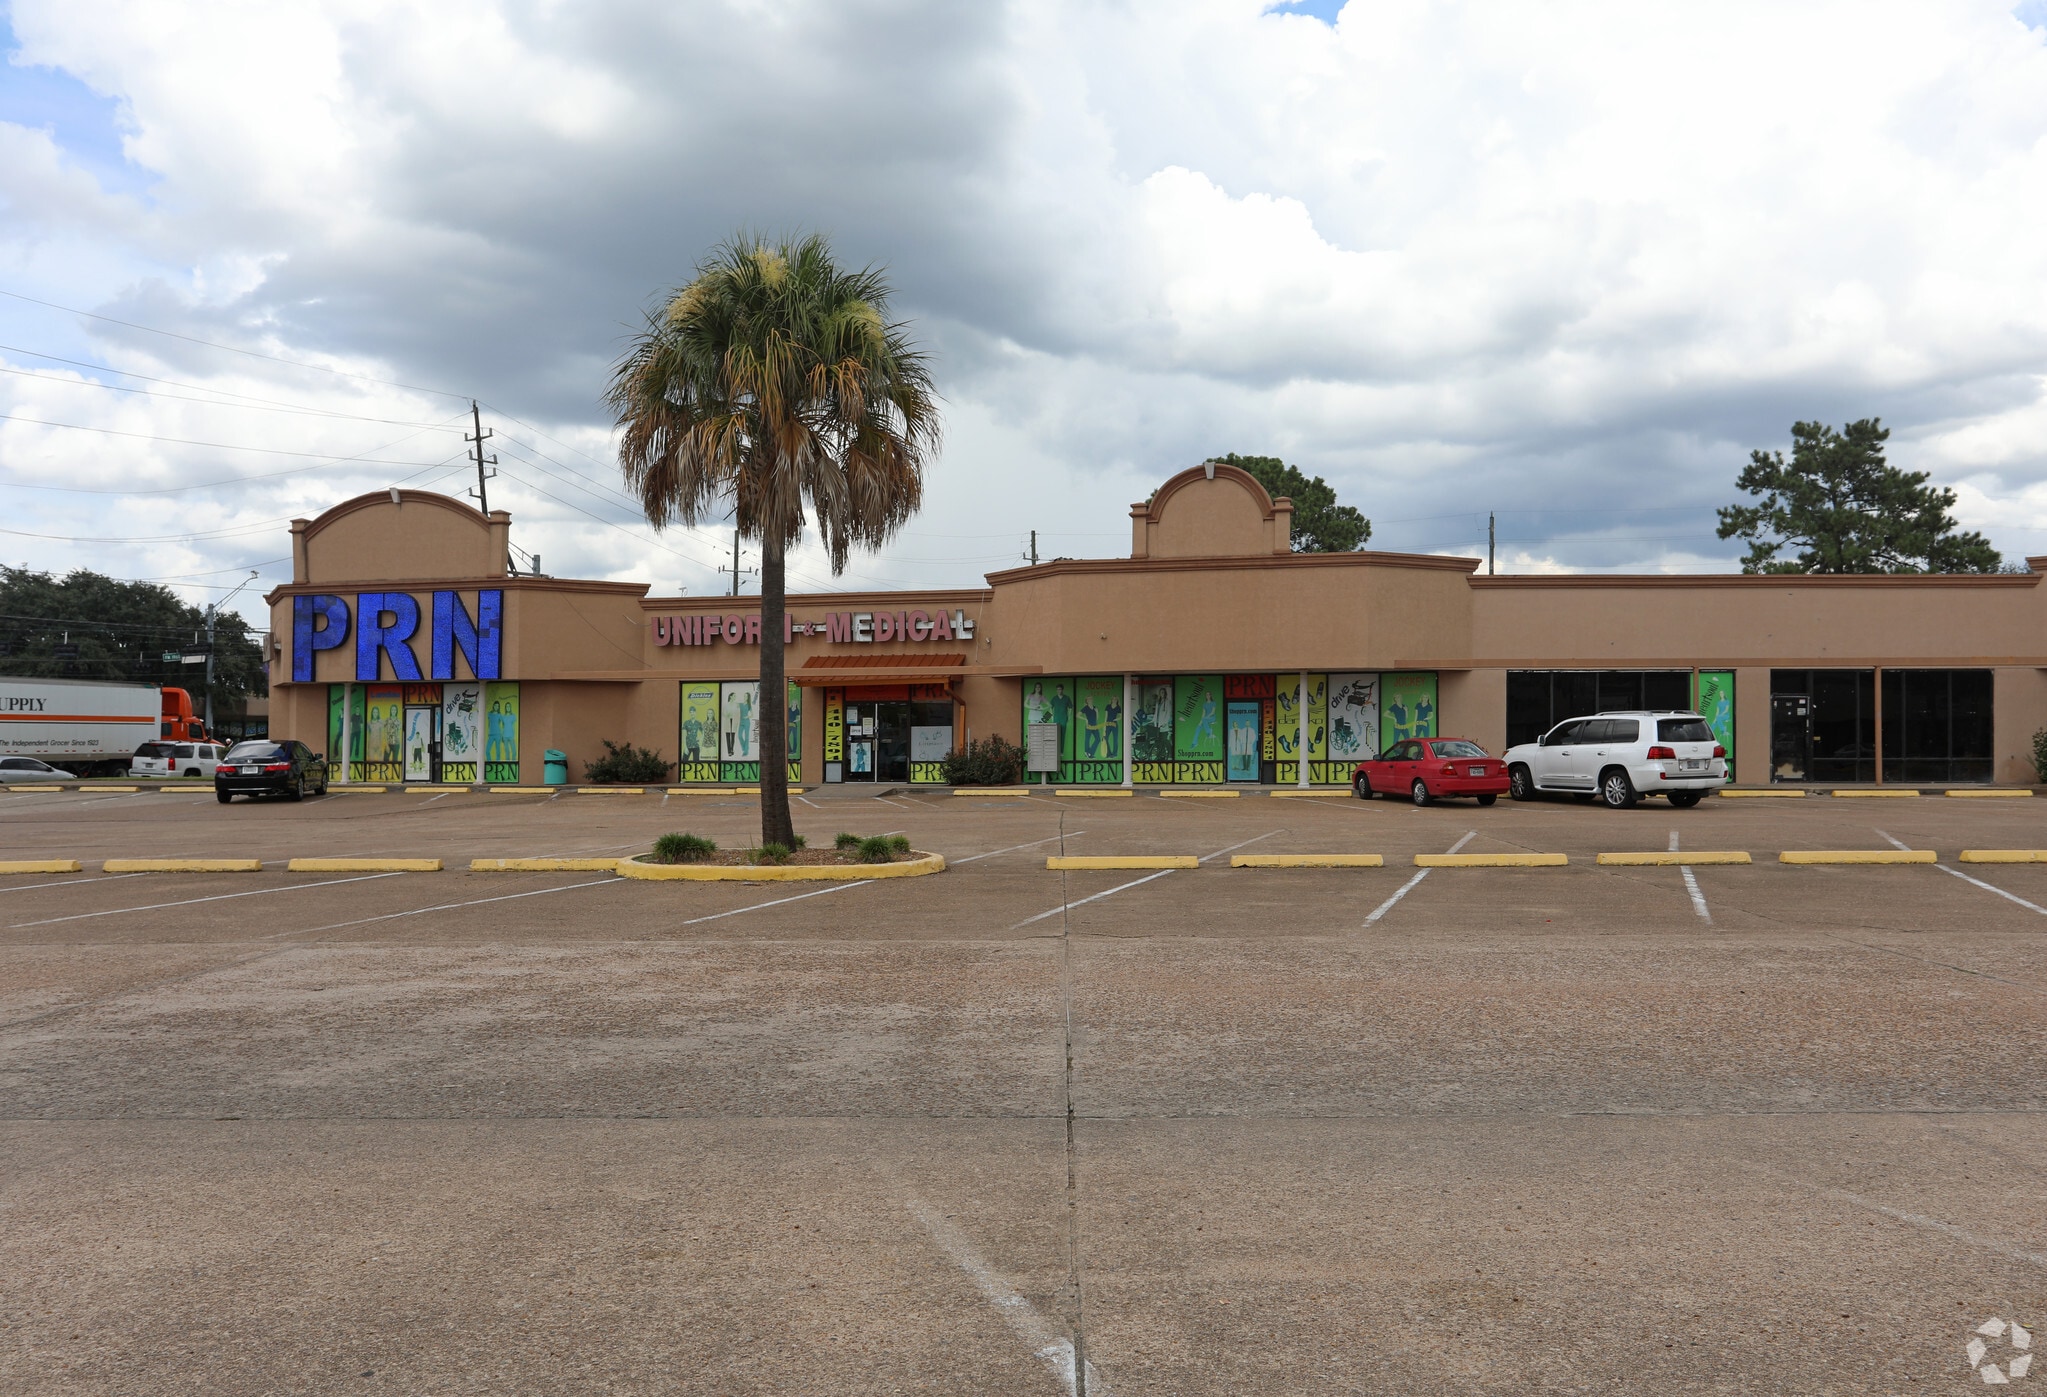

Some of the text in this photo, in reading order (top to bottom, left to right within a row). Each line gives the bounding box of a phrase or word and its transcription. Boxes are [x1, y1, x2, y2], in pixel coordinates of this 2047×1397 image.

[803, 620, 815, 636] &
[826, 609, 974, 643] MEDICAL
[292, 589, 504, 682] PRN
[1086, 681, 1116, 690] JOCKEY
[1228, 676, 1270, 695] PRN
[1394, 676, 1426, 688] JOCKEY
[405, 685, 441, 702] PRN
[1331, 685, 1350, 708] drive
[0, 697, 47, 711] UPPLY
[446, 693, 462, 714] drive
[1278, 714, 1323, 724] danko
[12, 739, 48, 747] Independent
[330, 763, 364, 780] PN
[366, 763, 401, 781] PRN
[443, 763, 477, 781] PRN
[681, 763, 718, 780] PRN
[721, 763, 758, 780] PRN
[1080, 763, 1118, 781] PRN
[1177, 763, 1219, 781] PRN
